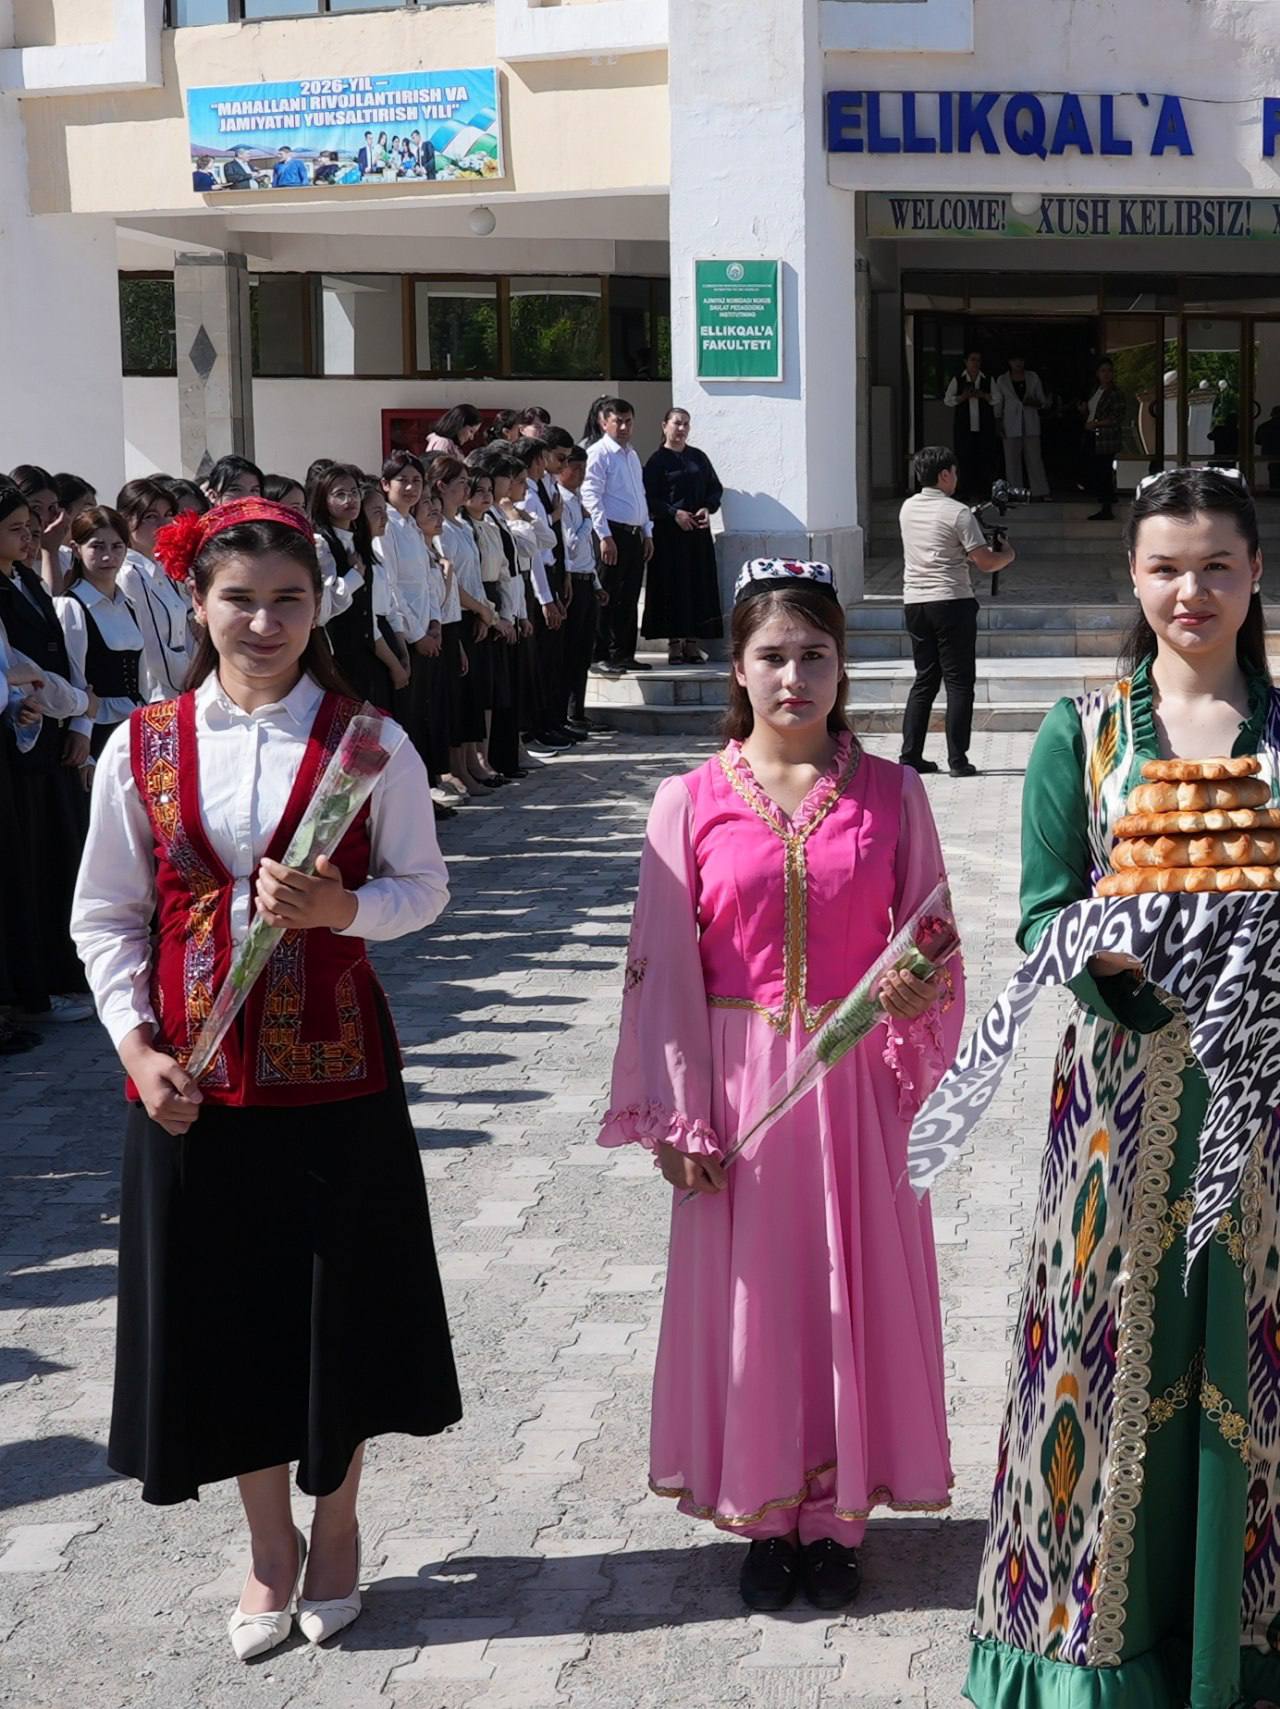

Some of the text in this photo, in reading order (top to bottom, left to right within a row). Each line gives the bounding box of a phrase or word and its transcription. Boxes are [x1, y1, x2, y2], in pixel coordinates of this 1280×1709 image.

[301, 77, 373, 95] 2026-YIL
[310, 88, 442, 110] RIVOJLANTIRISH
[445, 86, 468, 101] VA
[220, 114, 300, 132] JAMIYATNI
[304, 106, 418, 127] YUKSALTIRISH
[889, 199, 1006, 231] WELCOME!
[1036, 198, 1110, 235] XUSH
[1118, 199, 1251, 236] KELIBSIZ!
[703, 340, 771, 350] FAKULTETI
